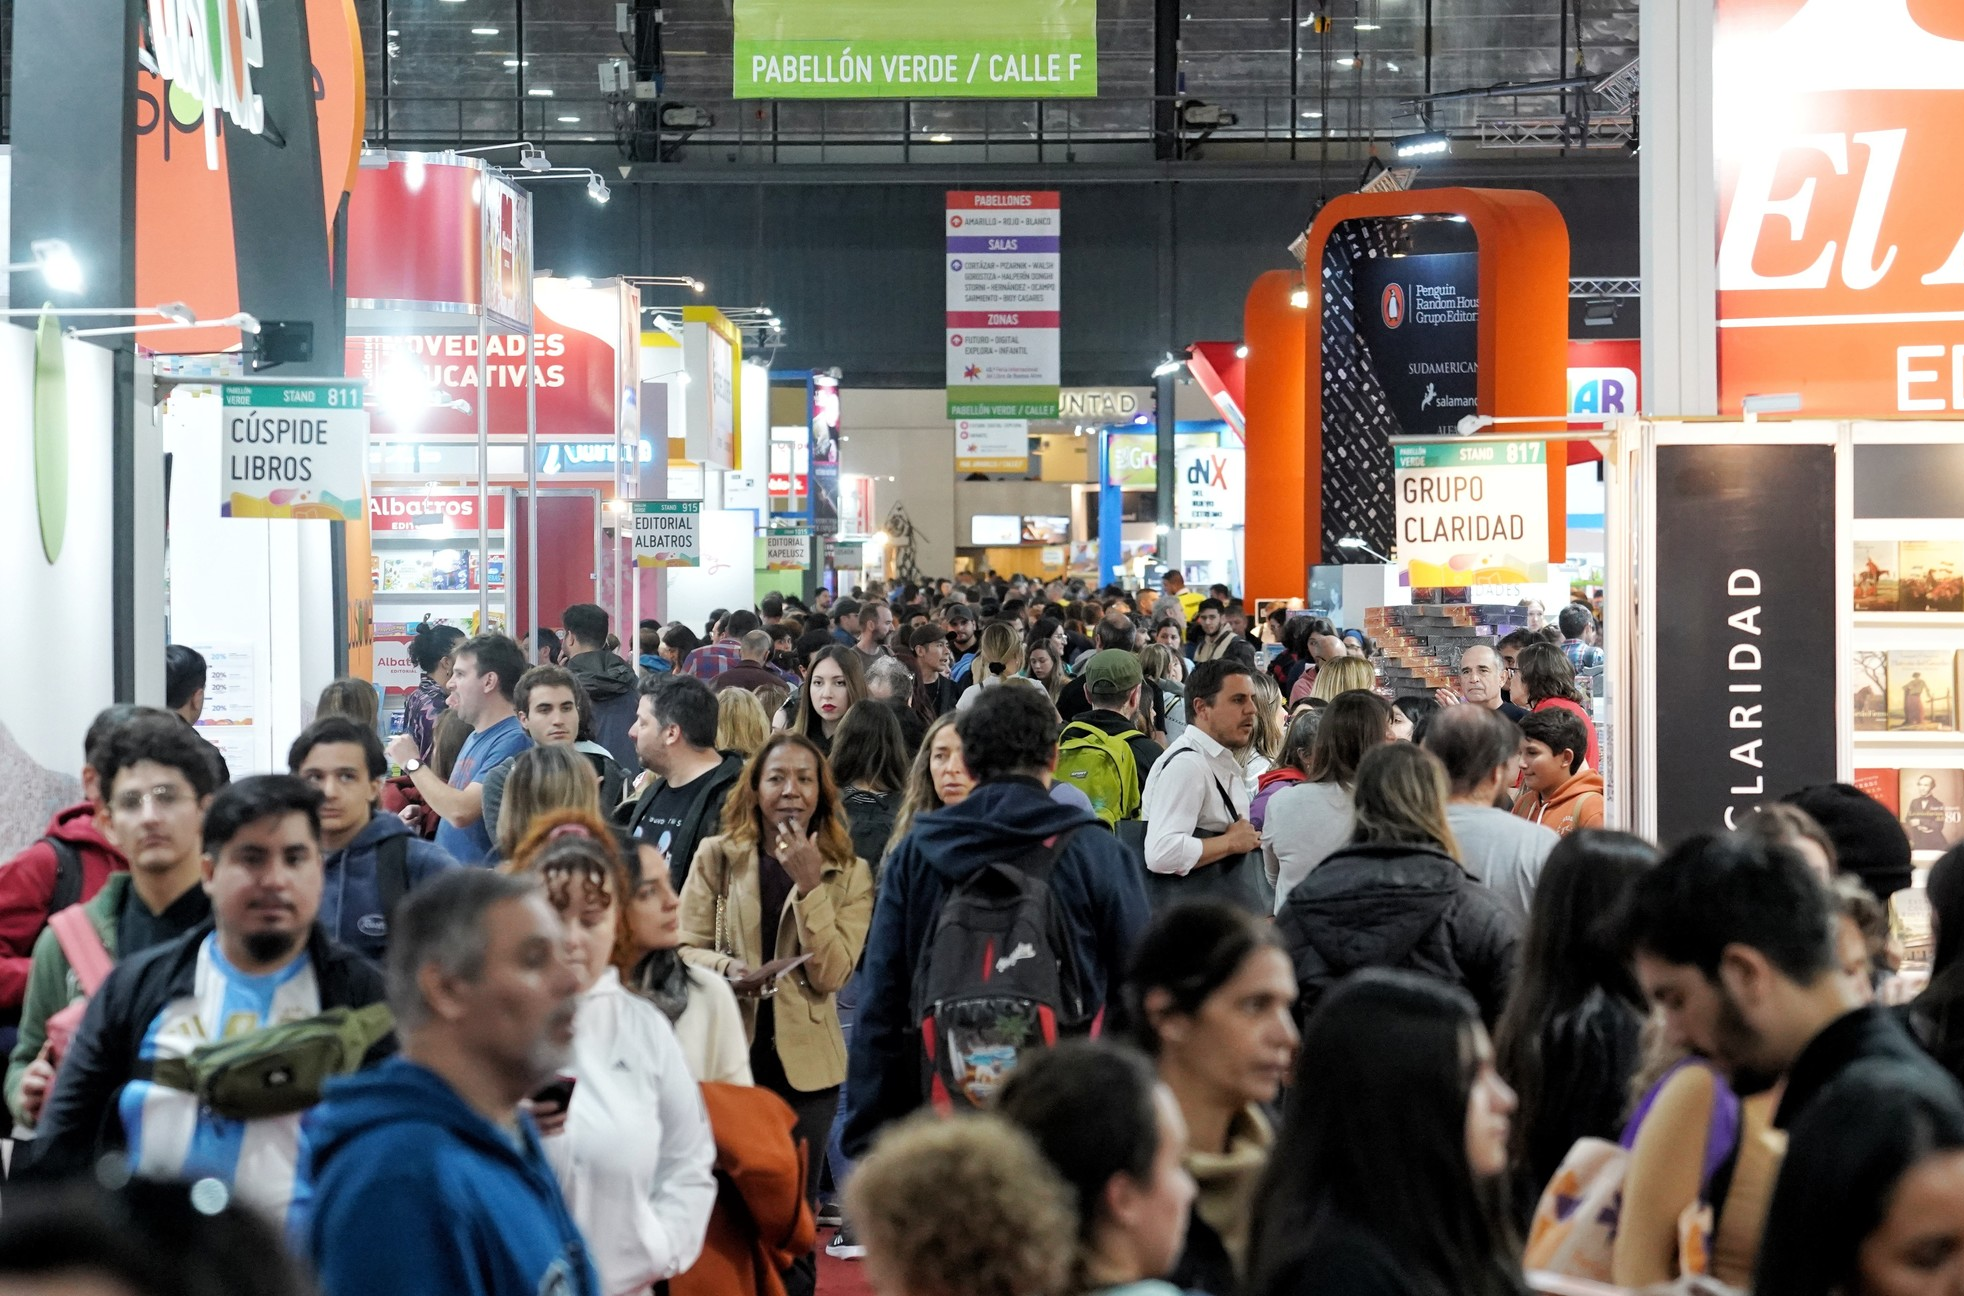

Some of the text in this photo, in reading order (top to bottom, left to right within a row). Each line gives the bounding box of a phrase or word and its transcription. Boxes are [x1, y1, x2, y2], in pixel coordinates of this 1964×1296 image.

[752, 47, 1082, 84] PABELLÓN VERDE / CALLE F
[974, 195, 1032, 206] PABELLONES
[1719, 128, 1907, 291] El
[1025, 217, 1051, 225] BLANCO
[988, 239, 1018, 250] SALAS
[1415, 284, 1456, 299] Penguin
[1416, 296, 1479, 310] Random Hous
[987, 314, 1019, 325] ZONAS
[1415, 310, 1479, 326] Grupo Editor
[964, 336, 1019, 344] FUTURO DIGITAL
[964, 347, 1028, 355] EXPLORA INFANTIL
[1408, 361, 1478, 375] SUDAMERICAN
[410, 365, 565, 387] UCATIVAS
[1897, 344, 1964, 411] E
[226, 396, 251, 405] VERDE
[283, 390, 316, 402] STAND
[327, 388, 358, 406] 811
[1570, 379, 1624, 413] AR
[951, 404, 990, 415] PABELLÓN
[992, 406, 1016, 415] VERDE
[1025, 406, 1048, 415] CALLE
[1050, 405, 1055, 414] F
[1059, 394, 1136, 414] UNTAD
[231, 410, 328, 445] CÚSPIDE
[1130, 447, 1157, 469] Gru
[1459, 447, 1494, 461] STAND
[1506, 442, 1540, 463] 817
[231, 455, 312, 481] LIBROS
[1400, 457, 1426, 467] VERDE
[1403, 475, 1483, 504] GRUPO
[369, 497, 473, 517] Albatros
[682, 503, 698, 512] 915
[635, 516, 693, 530] EDITORIAL
[1404, 514, 1524, 543] CLARIDAD
[635, 535, 693, 548] ALBATROS
[767, 538, 804, 546] EDITORIAL
[767, 548, 804, 558] KAPELUSZ
[1474, 583, 1521, 597] DADES
[377, 657, 413, 667] Albat
